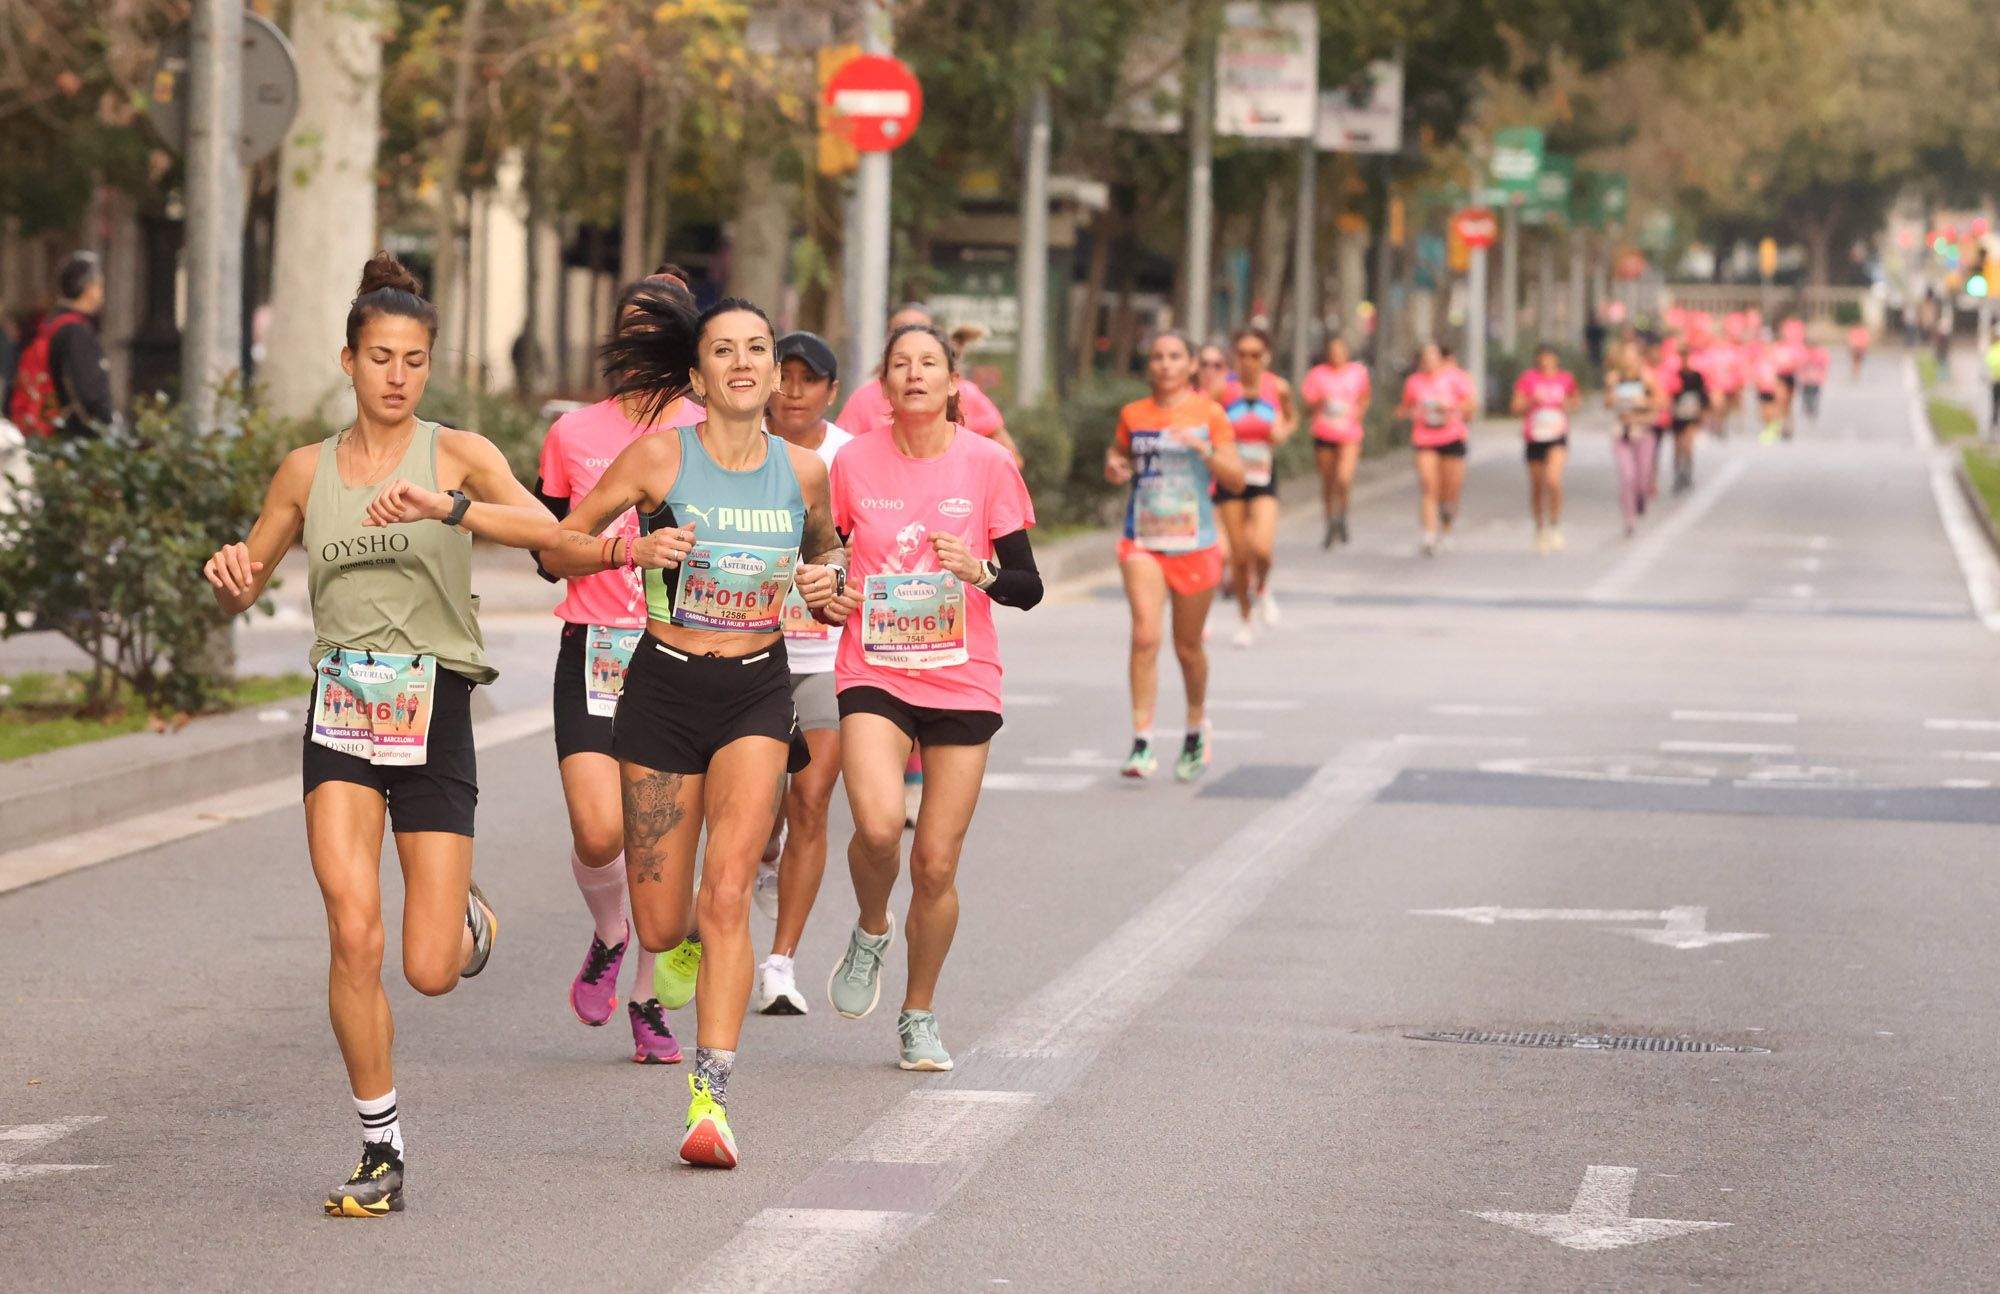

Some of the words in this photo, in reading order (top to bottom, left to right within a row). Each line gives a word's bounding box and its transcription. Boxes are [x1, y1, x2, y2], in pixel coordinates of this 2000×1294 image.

[861, 498, 904, 510] OYSHO
[718, 507, 794, 533] PUMA
[322, 533, 409, 562] OYSHO
[339, 559, 374, 571] RUNNING
[375, 557, 396, 565] CLUB
[720, 560, 763, 572] ASTURIANA
[716, 589, 757, 608] 016
[896, 587, 935, 597] ASTURIANA
[685, 612, 708, 623] CARRERA
[718, 618, 726, 626] LA
[720, 610, 747, 620] 12586
[897, 615, 936, 631] 016
[349, 667, 394, 680] ASTURIANA
[325, 728, 351, 737] CARRERA
[377, 751, 412, 759] Santander
